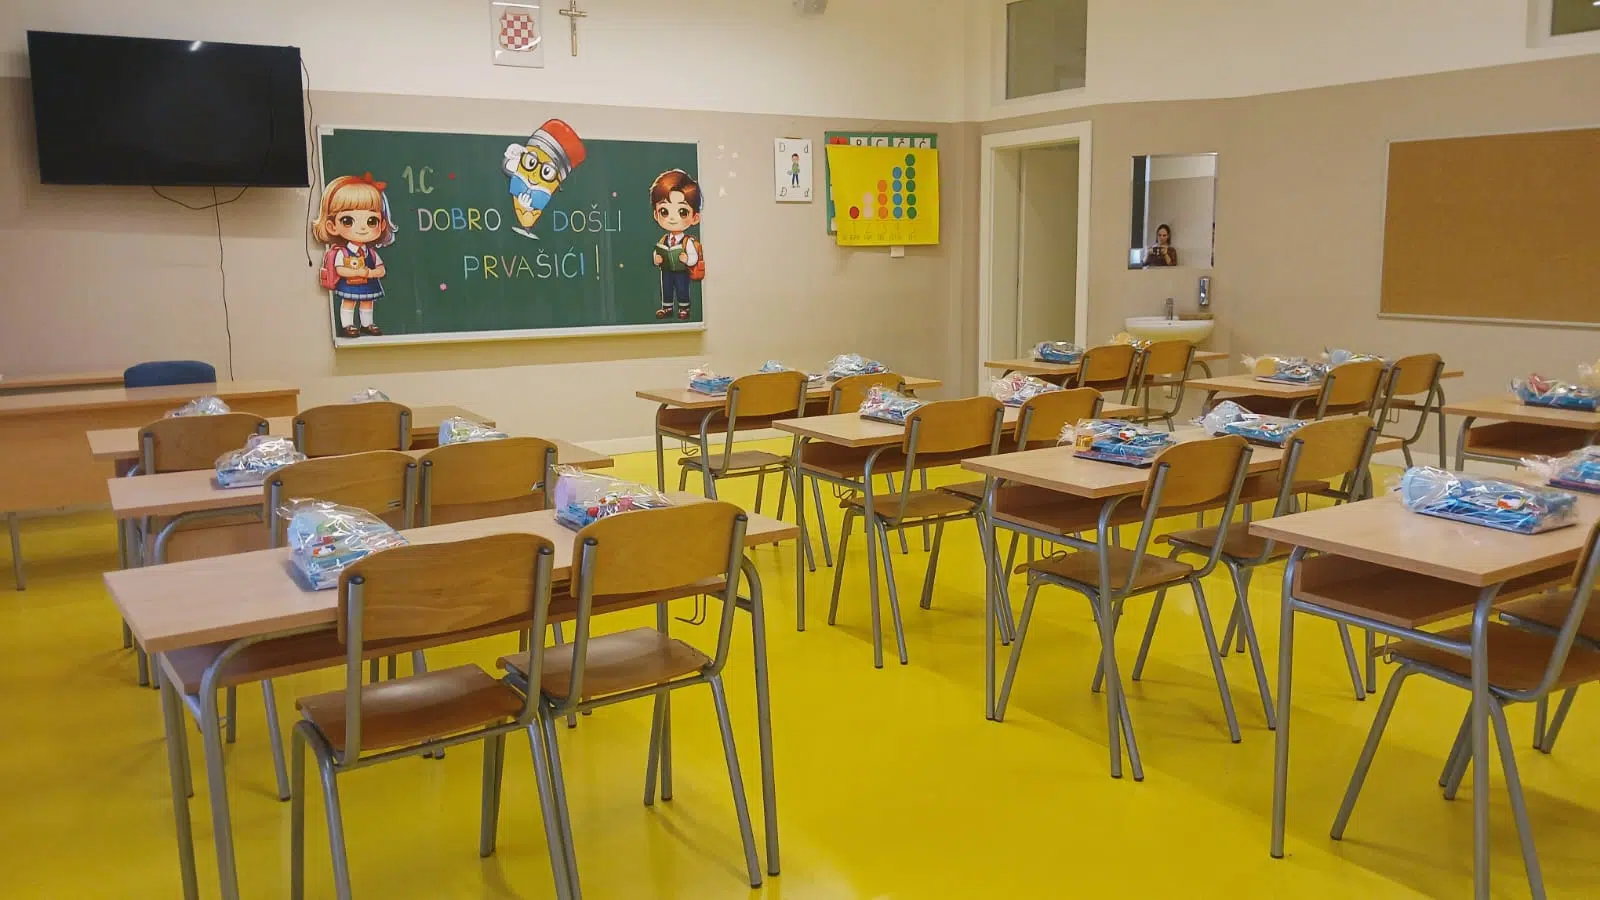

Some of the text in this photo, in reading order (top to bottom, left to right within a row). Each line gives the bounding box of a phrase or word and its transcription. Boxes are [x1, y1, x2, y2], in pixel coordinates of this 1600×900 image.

[402, 166, 434, 194] 1.C
[417, 203, 622, 233] DOBRO DOŠLI
[463, 246, 585, 280] PRVAŠIĆI
